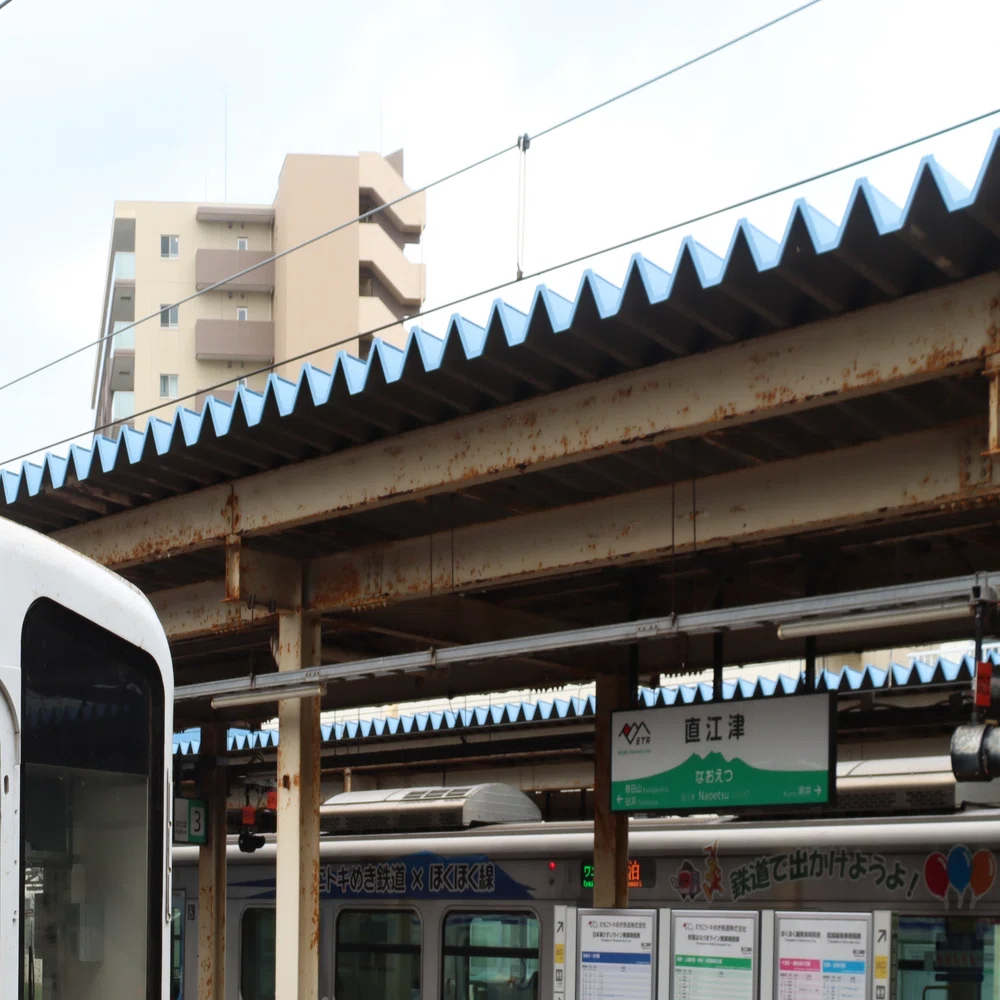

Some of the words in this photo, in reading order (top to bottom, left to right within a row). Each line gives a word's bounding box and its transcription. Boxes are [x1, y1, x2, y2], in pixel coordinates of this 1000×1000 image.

[685, 713, 745, 744] 直江津
[695, 768, 734, 785] なおえつ
[698, 790, 730, 801] Naoetsu
[194, 810, 201, 832] 3
[429, 864, 494, 892] ほくほく線
